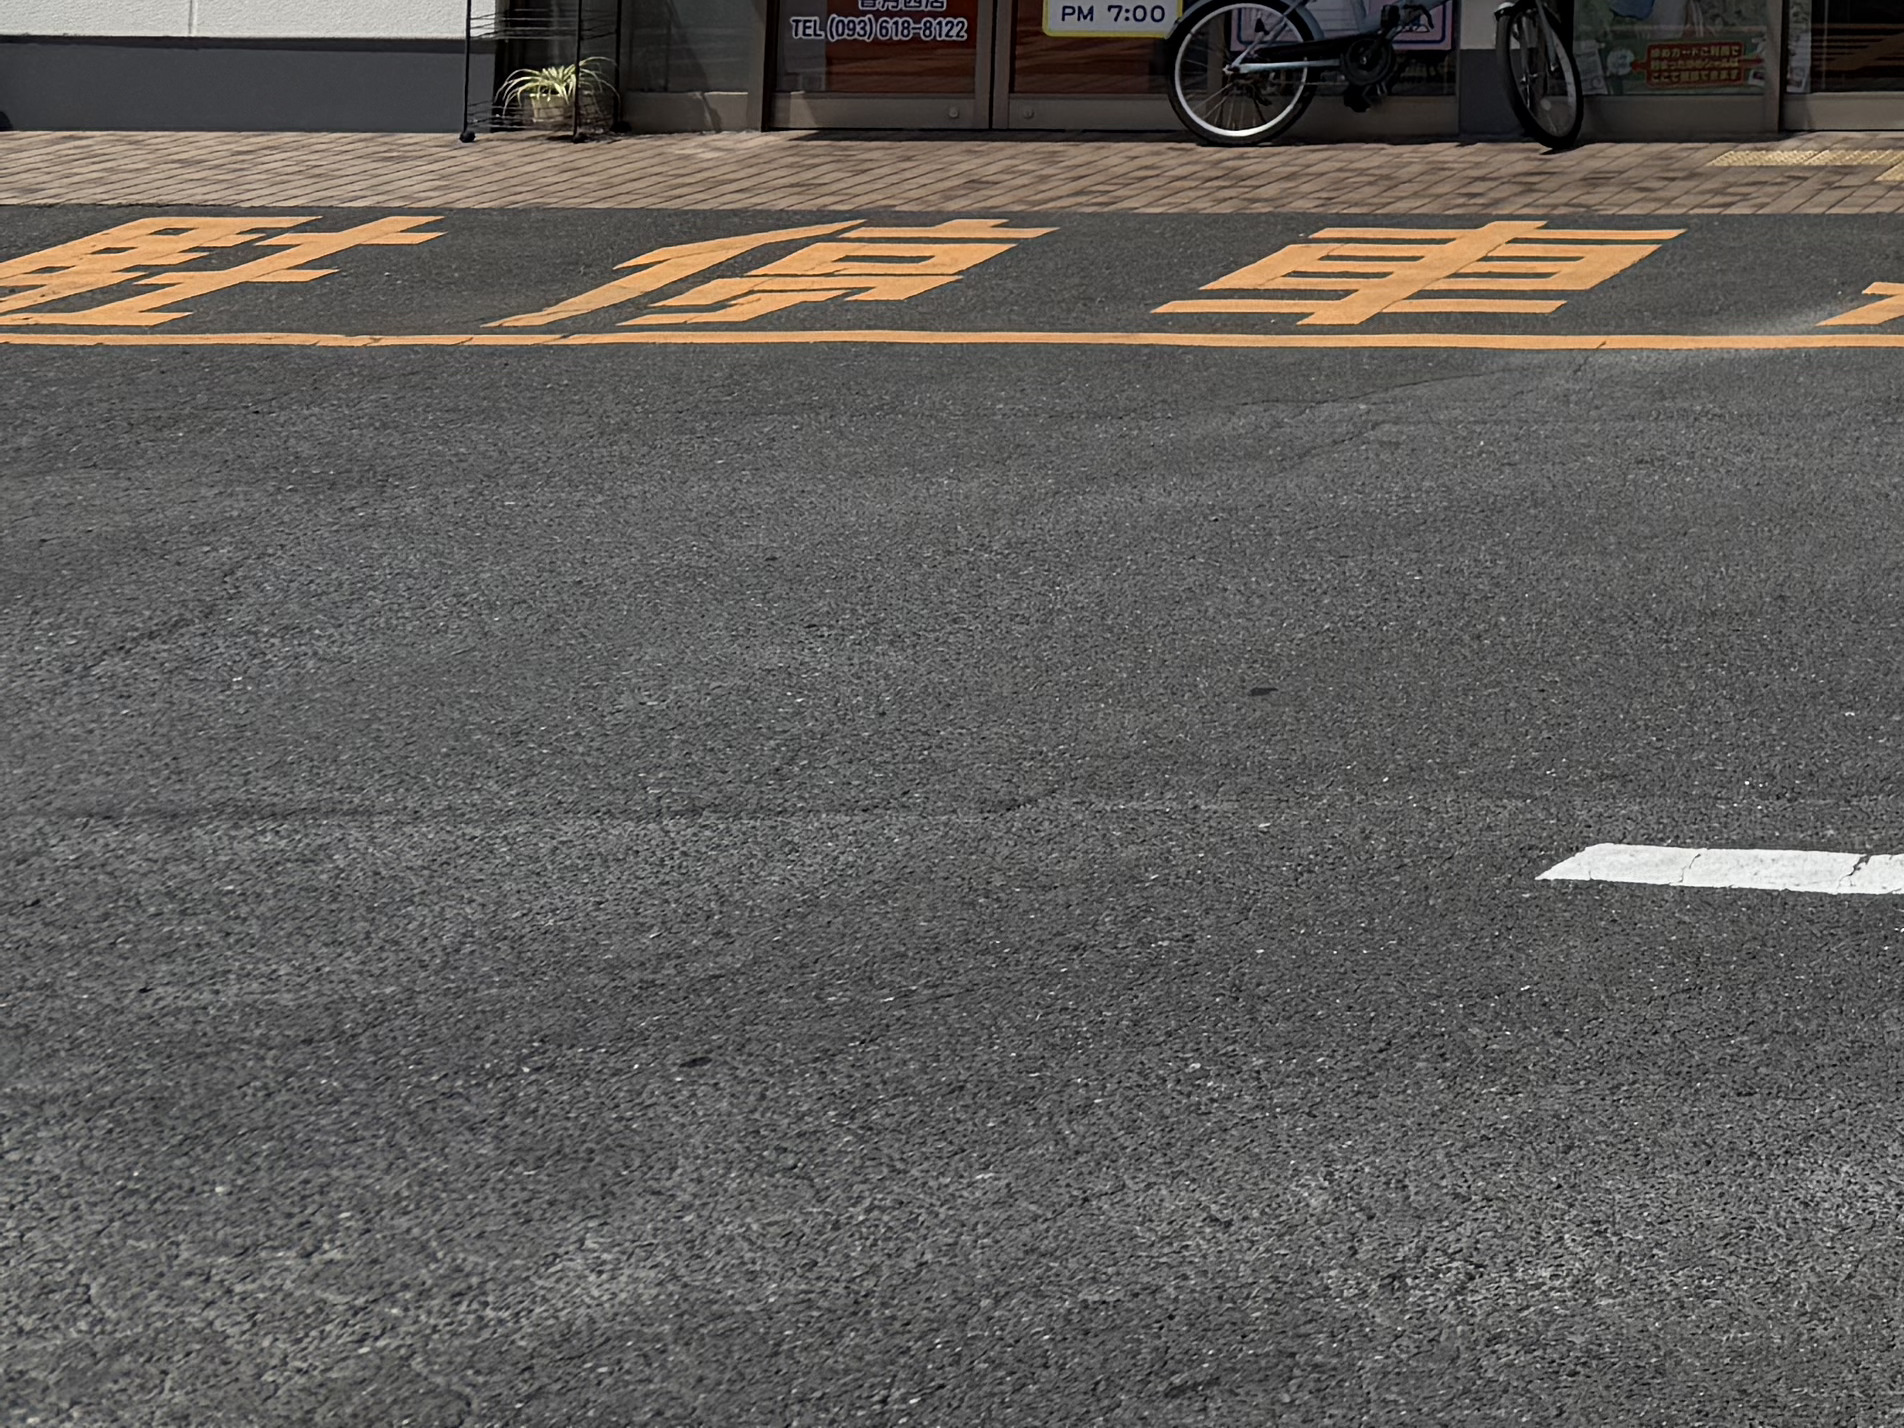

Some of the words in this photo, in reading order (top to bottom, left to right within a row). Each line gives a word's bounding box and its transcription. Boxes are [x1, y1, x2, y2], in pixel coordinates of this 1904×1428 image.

[1061, 5, 1095, 22] PM
[1107, 5, 1166, 22] 7:00
[791, 17, 823, 39] TEL
